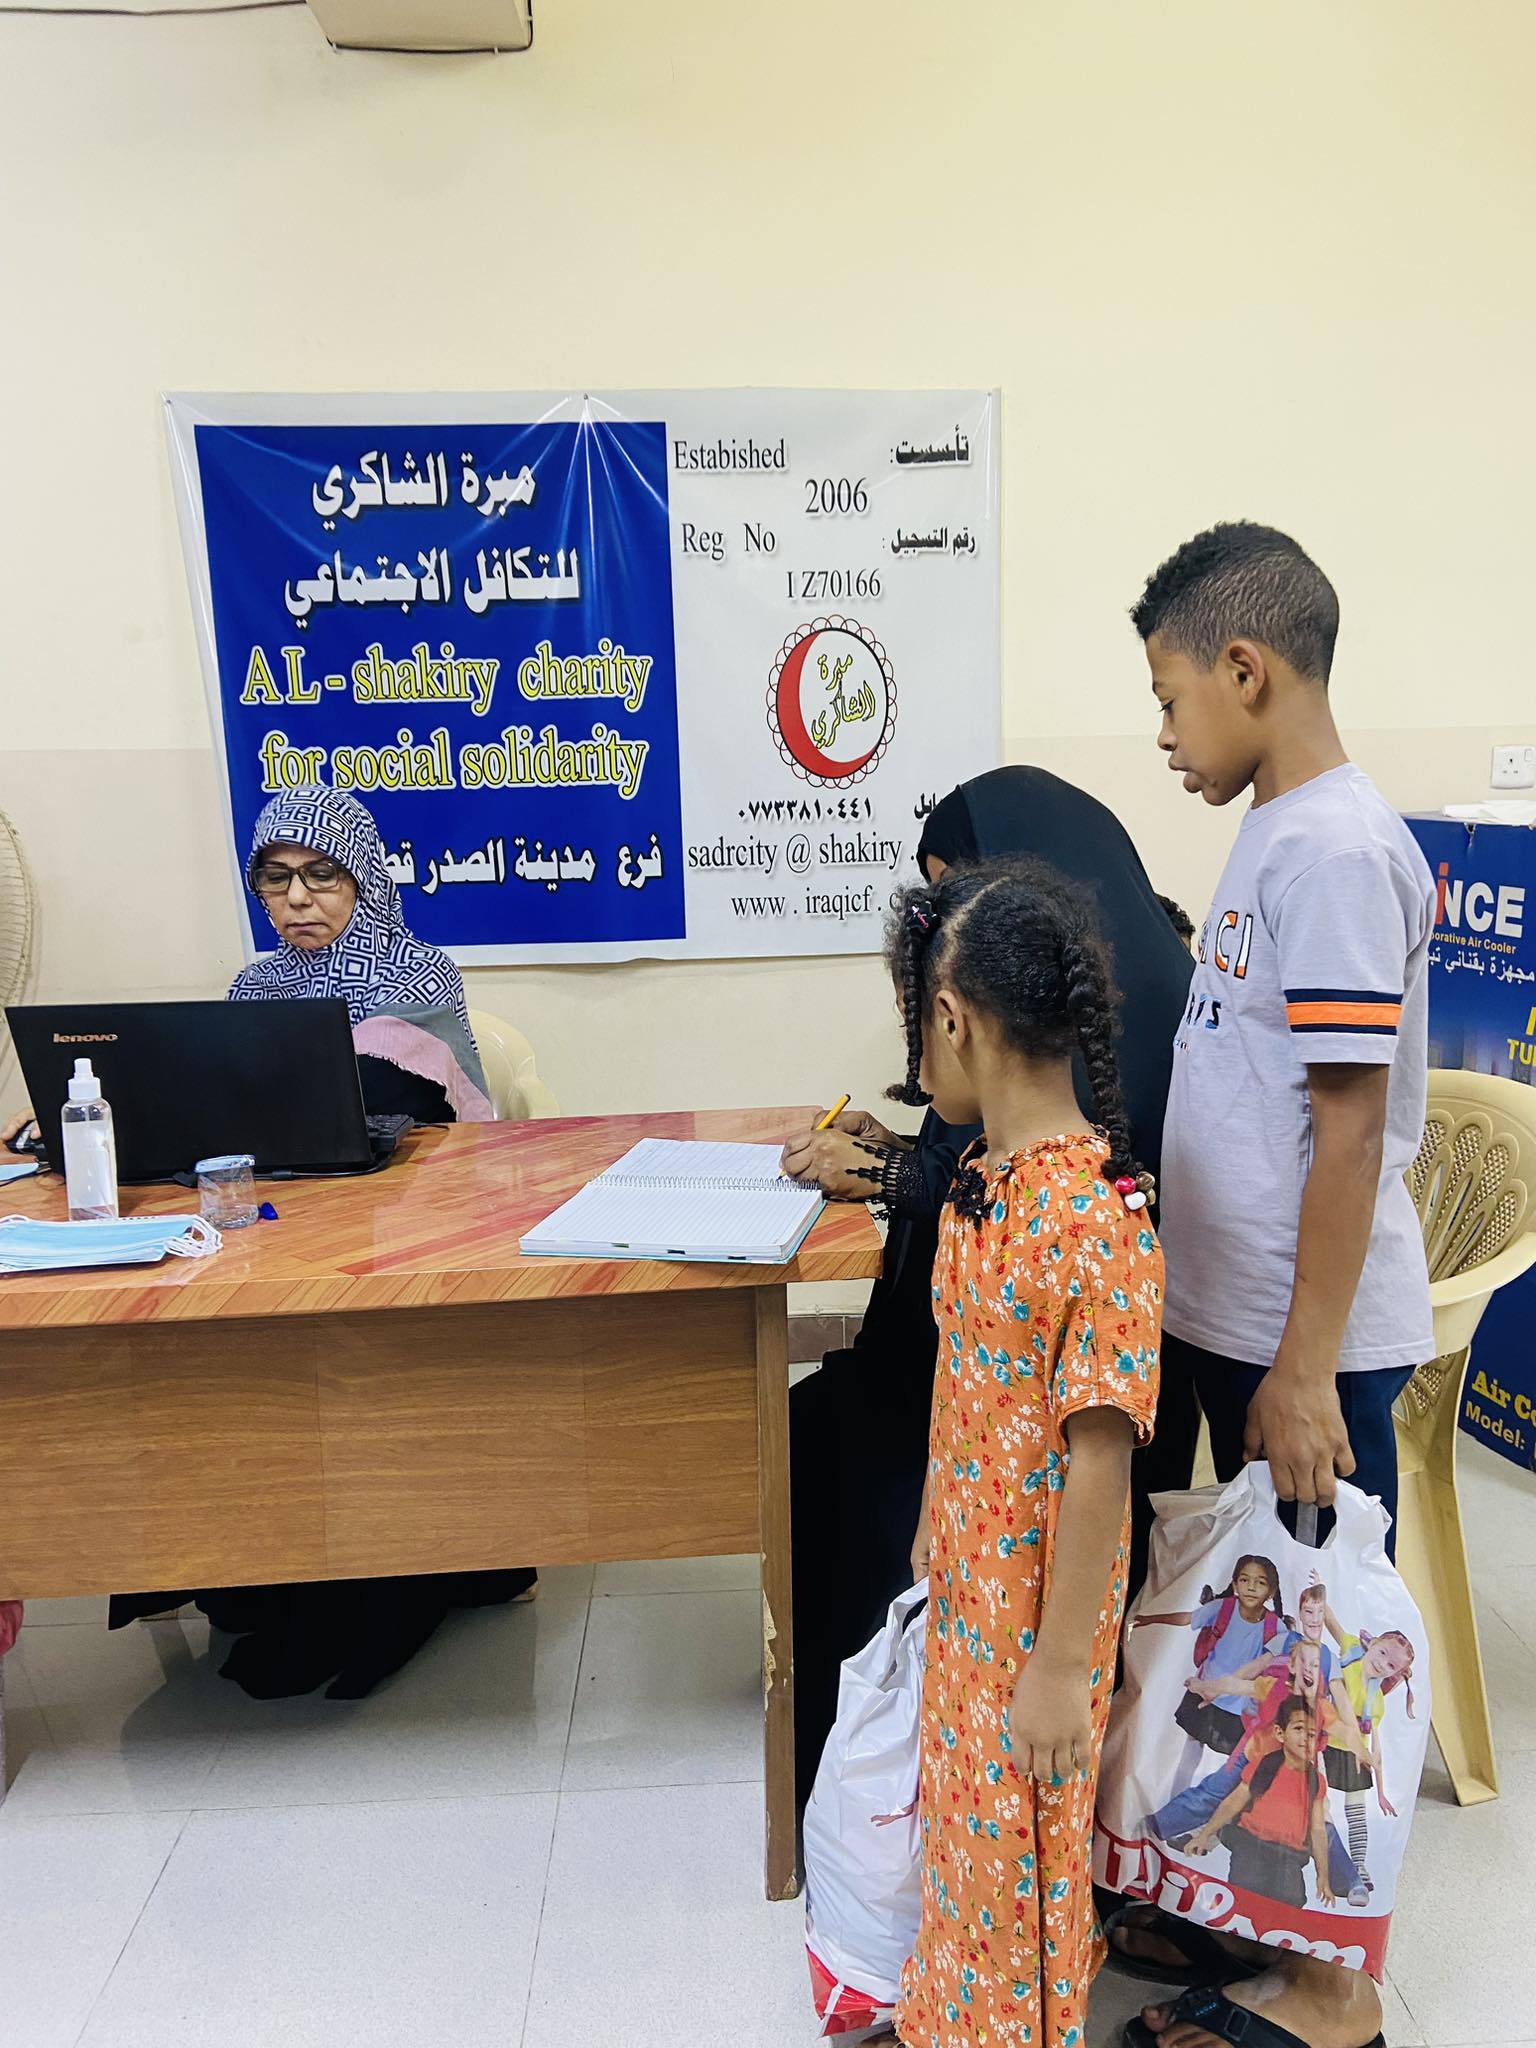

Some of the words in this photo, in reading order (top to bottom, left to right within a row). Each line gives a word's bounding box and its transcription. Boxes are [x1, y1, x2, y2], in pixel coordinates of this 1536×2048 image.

[674, 438, 786, 469] Estabished
[312, 450, 449, 531] الشاكري
[461, 451, 536, 516] مبرة
[805, 477, 868, 513] 2006
[682, 523, 724, 560] Reg
[743, 523, 775, 552] No
[952, 527, 975, 555] رقم
[284, 546, 451, 628] الاجتماعي
[464, 546, 580, 614] للتكافل
[353, 641, 500, 715] shakiry
[518, 638, 654, 713] charity
[261, 729, 328, 792] for
[329, 727, 459, 791] social
[460, 723, 649, 798] solidarity
[421, 838, 506, 894] الصدر
[514, 837, 596, 891] مدينة
[617, 834, 662, 889] فرع
[688, 836, 778, 873] sadrcity
[819, 831, 902, 871] shakiry
[1467, 937, 1482, 948] Air
[1483, 939, 1517, 955] Cooler
[53, 1033, 118, 1043] lenovo
[1507, 1038, 1536, 1067] TU
[1472, 1370, 1511, 1409] Air
